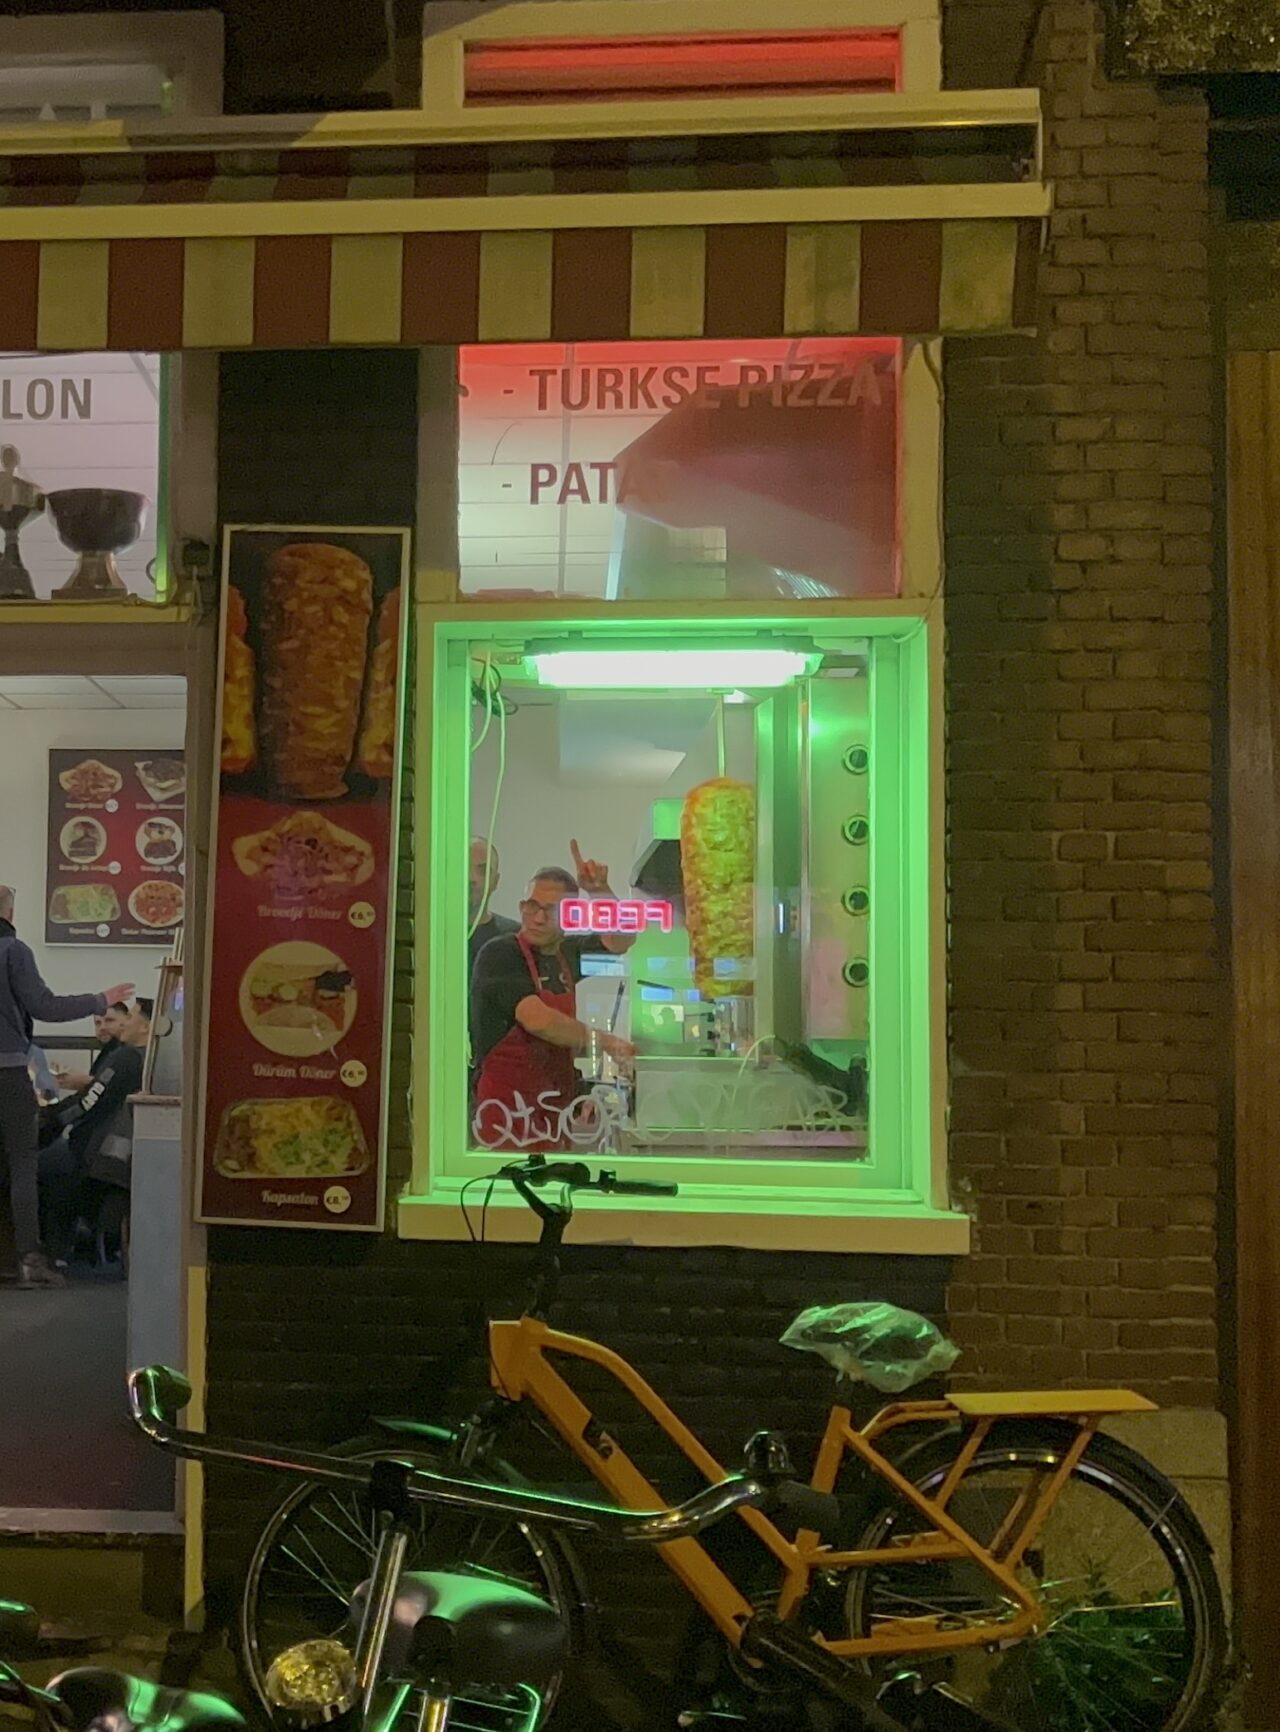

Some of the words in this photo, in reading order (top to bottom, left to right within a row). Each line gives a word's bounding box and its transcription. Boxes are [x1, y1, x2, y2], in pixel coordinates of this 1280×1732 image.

[529, 365, 721, 412] TURKSE
[738, 361, 883, 409] PIZZA
[261, 1189, 319, 1207] Kapsalon
